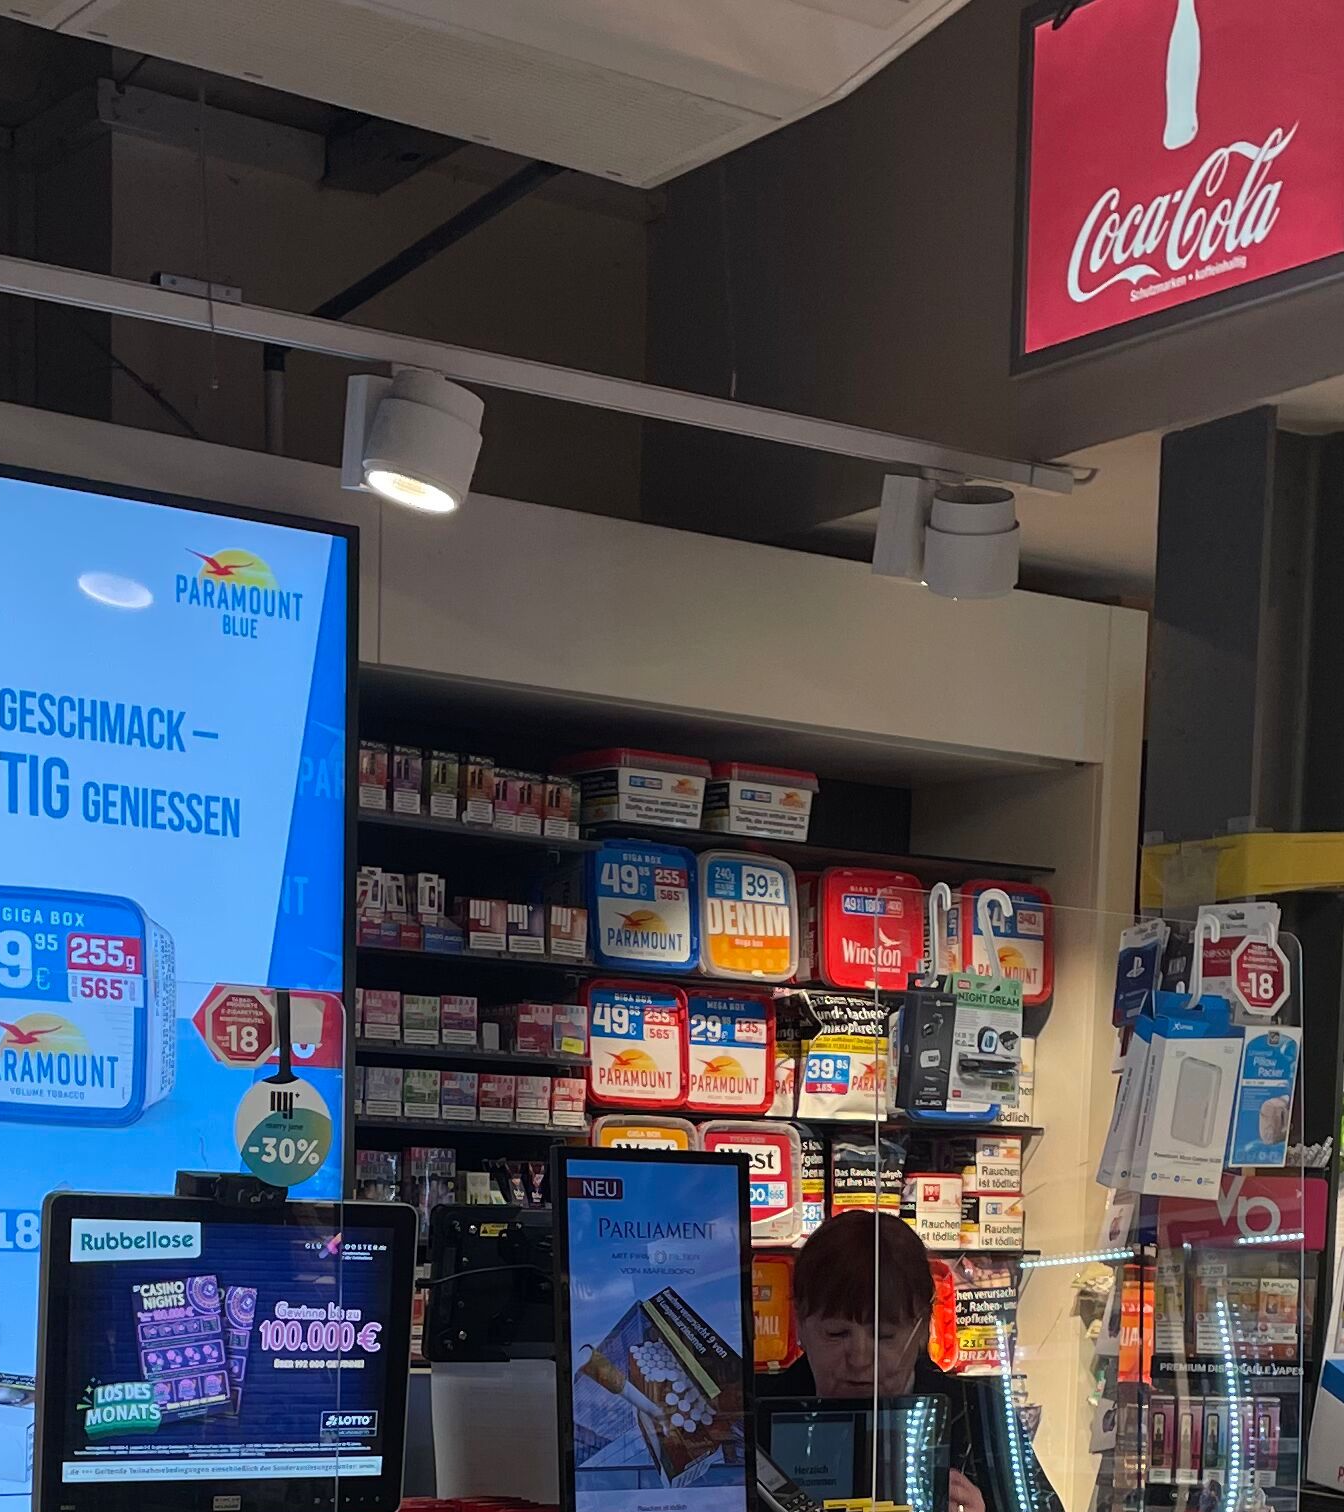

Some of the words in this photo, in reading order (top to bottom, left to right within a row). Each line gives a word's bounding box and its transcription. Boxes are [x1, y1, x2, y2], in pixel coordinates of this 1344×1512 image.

[1067, 120, 1299, 302] Coca-Cola
[1130, 275, 1186, 302] Schutzmarken
[175, 575, 303, 621] PARAMOUNT
[222, 614, 258, 639] BLUE
[83, 784, 240, 838] GENIESSEN
[601, 863, 639, 894] 49
[2, 907, 43, 924] GIGA
[51, 910, 85, 926] BOX
[707, 899, 790, 937] DENIM
[607, 927, 682, 951] PARAMOUNT
[35, 934, 58, 951] 95
[70, 936, 135, 971] 255g
[842, 938, 901, 967] Winston
[1248, 973, 1273, 999] 18
[958, 992, 986, 1003] NIGHT
[989, 994, 1020, 1007] DREAM
[593, 1004, 628, 1035] 49
[691, 1015, 720, 1041] 29
[227, 1025, 259, 1053] 18
[599, 1067, 672, 1090] PARAMOUNT
[807, 1059, 832, 1079] 39
[10, 1087, 45, 1098] VOLUME
[50, 1090, 85, 1099] TOBACCO
[690, 1074, 759, 1095] PARAMOUNT
[249, 1138, 320, 1165] -30%
[982, 1165, 1019, 1177] Rauchen
[583, 1181, 617, 1197] NEU
[979, 1179, 989, 1188] ist
[991, 1177, 1021, 1188] tödlich
[599, 1218, 716, 1239] PARLIAMENT
[921, 1219, 959, 1230] Rauchen
[985, 1224, 1022, 1234] Rauchen
[81, 1232, 194, 1251] Rubbellose
[981, 1236, 992, 1246] ist
[141, 1282, 184, 1296] CASINO
[144, 1295, 185, 1308] NIGHTS
[275, 1301, 325, 1320] Gewinne
[347, 1309, 361, 1320] zu
[259, 1320, 354, 1351] 100.000
[358, 1322, 382, 1352] €
[1160, 1362, 1205, 1373] PREMIUM
[98, 1385, 123, 1403] LOS
[124, 1384, 150, 1401] DES
[87, 1404, 161, 1426] MONATS
[338, 1415, 370, 1426] LOTTO
